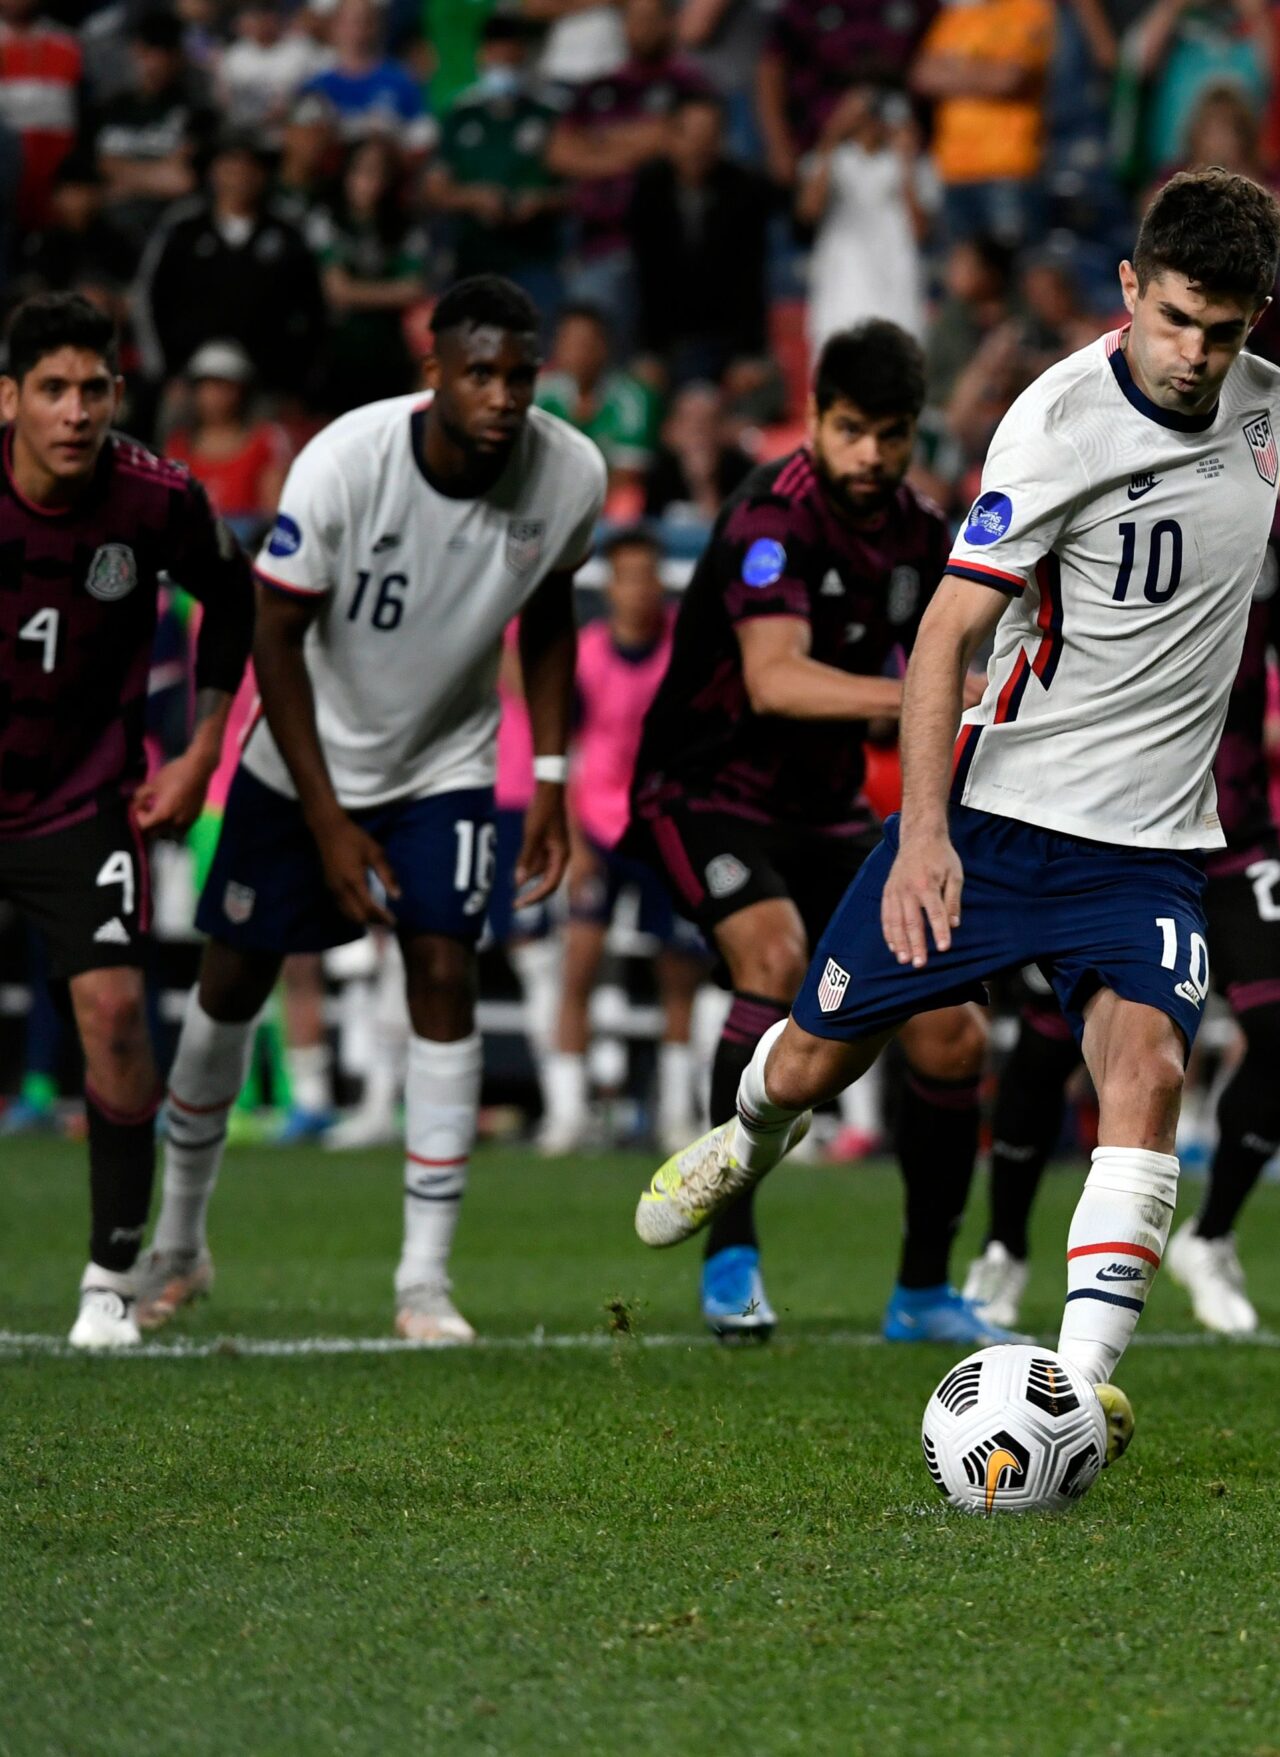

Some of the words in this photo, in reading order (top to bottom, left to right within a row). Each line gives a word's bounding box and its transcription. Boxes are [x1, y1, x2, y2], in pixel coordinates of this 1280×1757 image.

[1247, 420, 1270, 448] USA
[1131, 471, 1155, 489] NIKE
[1111, 518, 1183, 604] 10
[347, 570, 409, 632] 16
[18, 607, 60, 673] 4
[96, 850, 135, 915] 4
[826, 961, 848, 988] USA
[1155, 917, 1210, 1001] 10
[1106, 1263, 1143, 1278] NIKE
